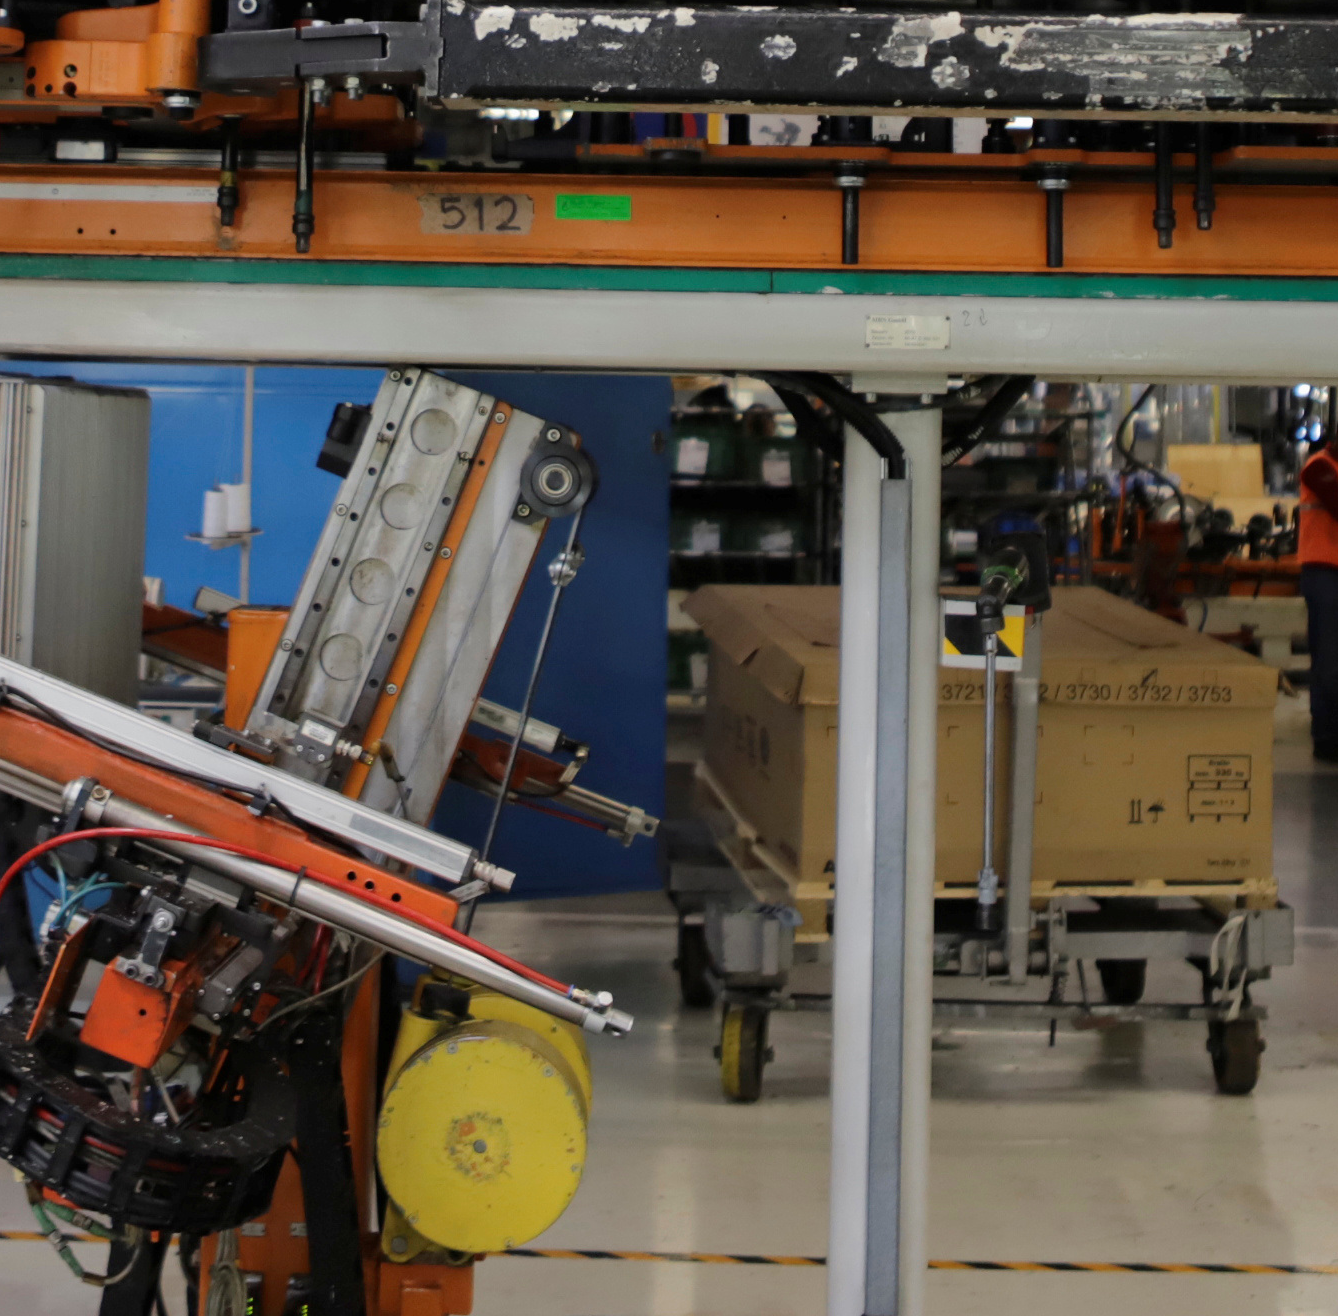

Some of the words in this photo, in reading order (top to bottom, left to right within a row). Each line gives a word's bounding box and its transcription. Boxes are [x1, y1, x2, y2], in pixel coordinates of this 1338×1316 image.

[440, 195, 521, 231] 512
[1066, 684, 1111, 701] 3730
[1128, 685, 1172, 702] 3732
[1188, 686, 1233, 703] 3753
